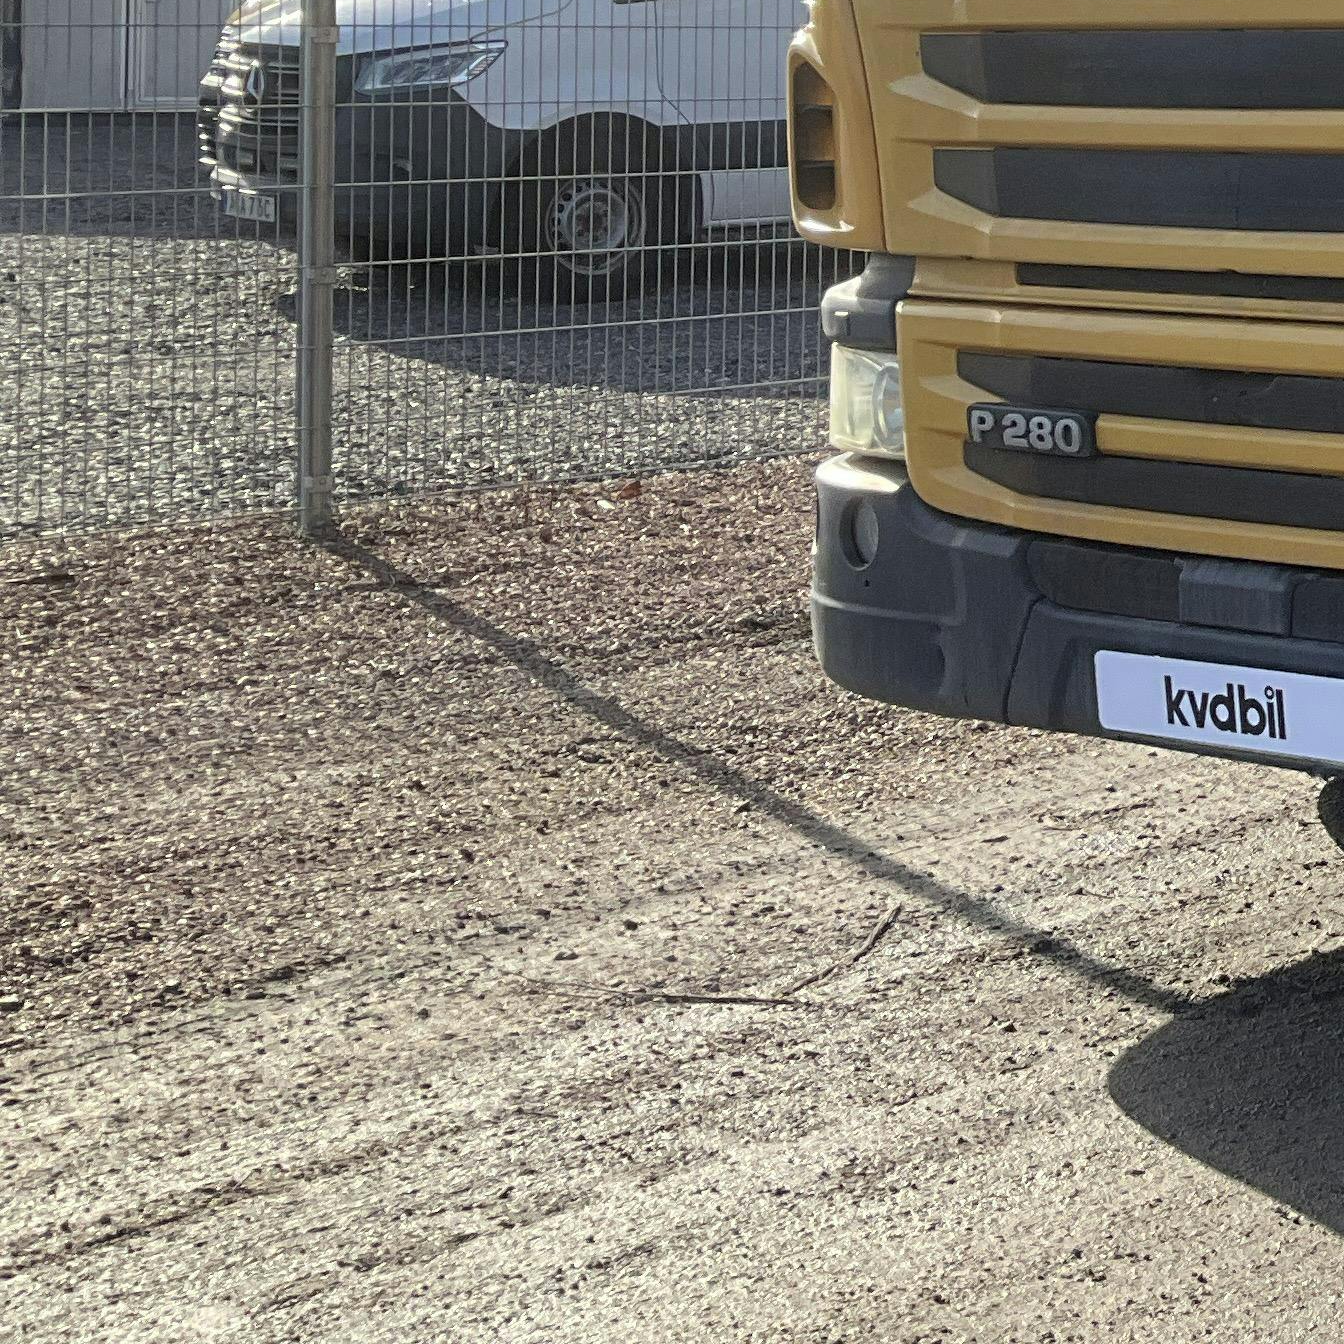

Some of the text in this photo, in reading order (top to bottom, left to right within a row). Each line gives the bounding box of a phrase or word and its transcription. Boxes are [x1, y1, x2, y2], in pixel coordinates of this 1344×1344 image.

[970, 409, 1081, 453] P 280
[1164, 674, 1287, 740] kvdbil
